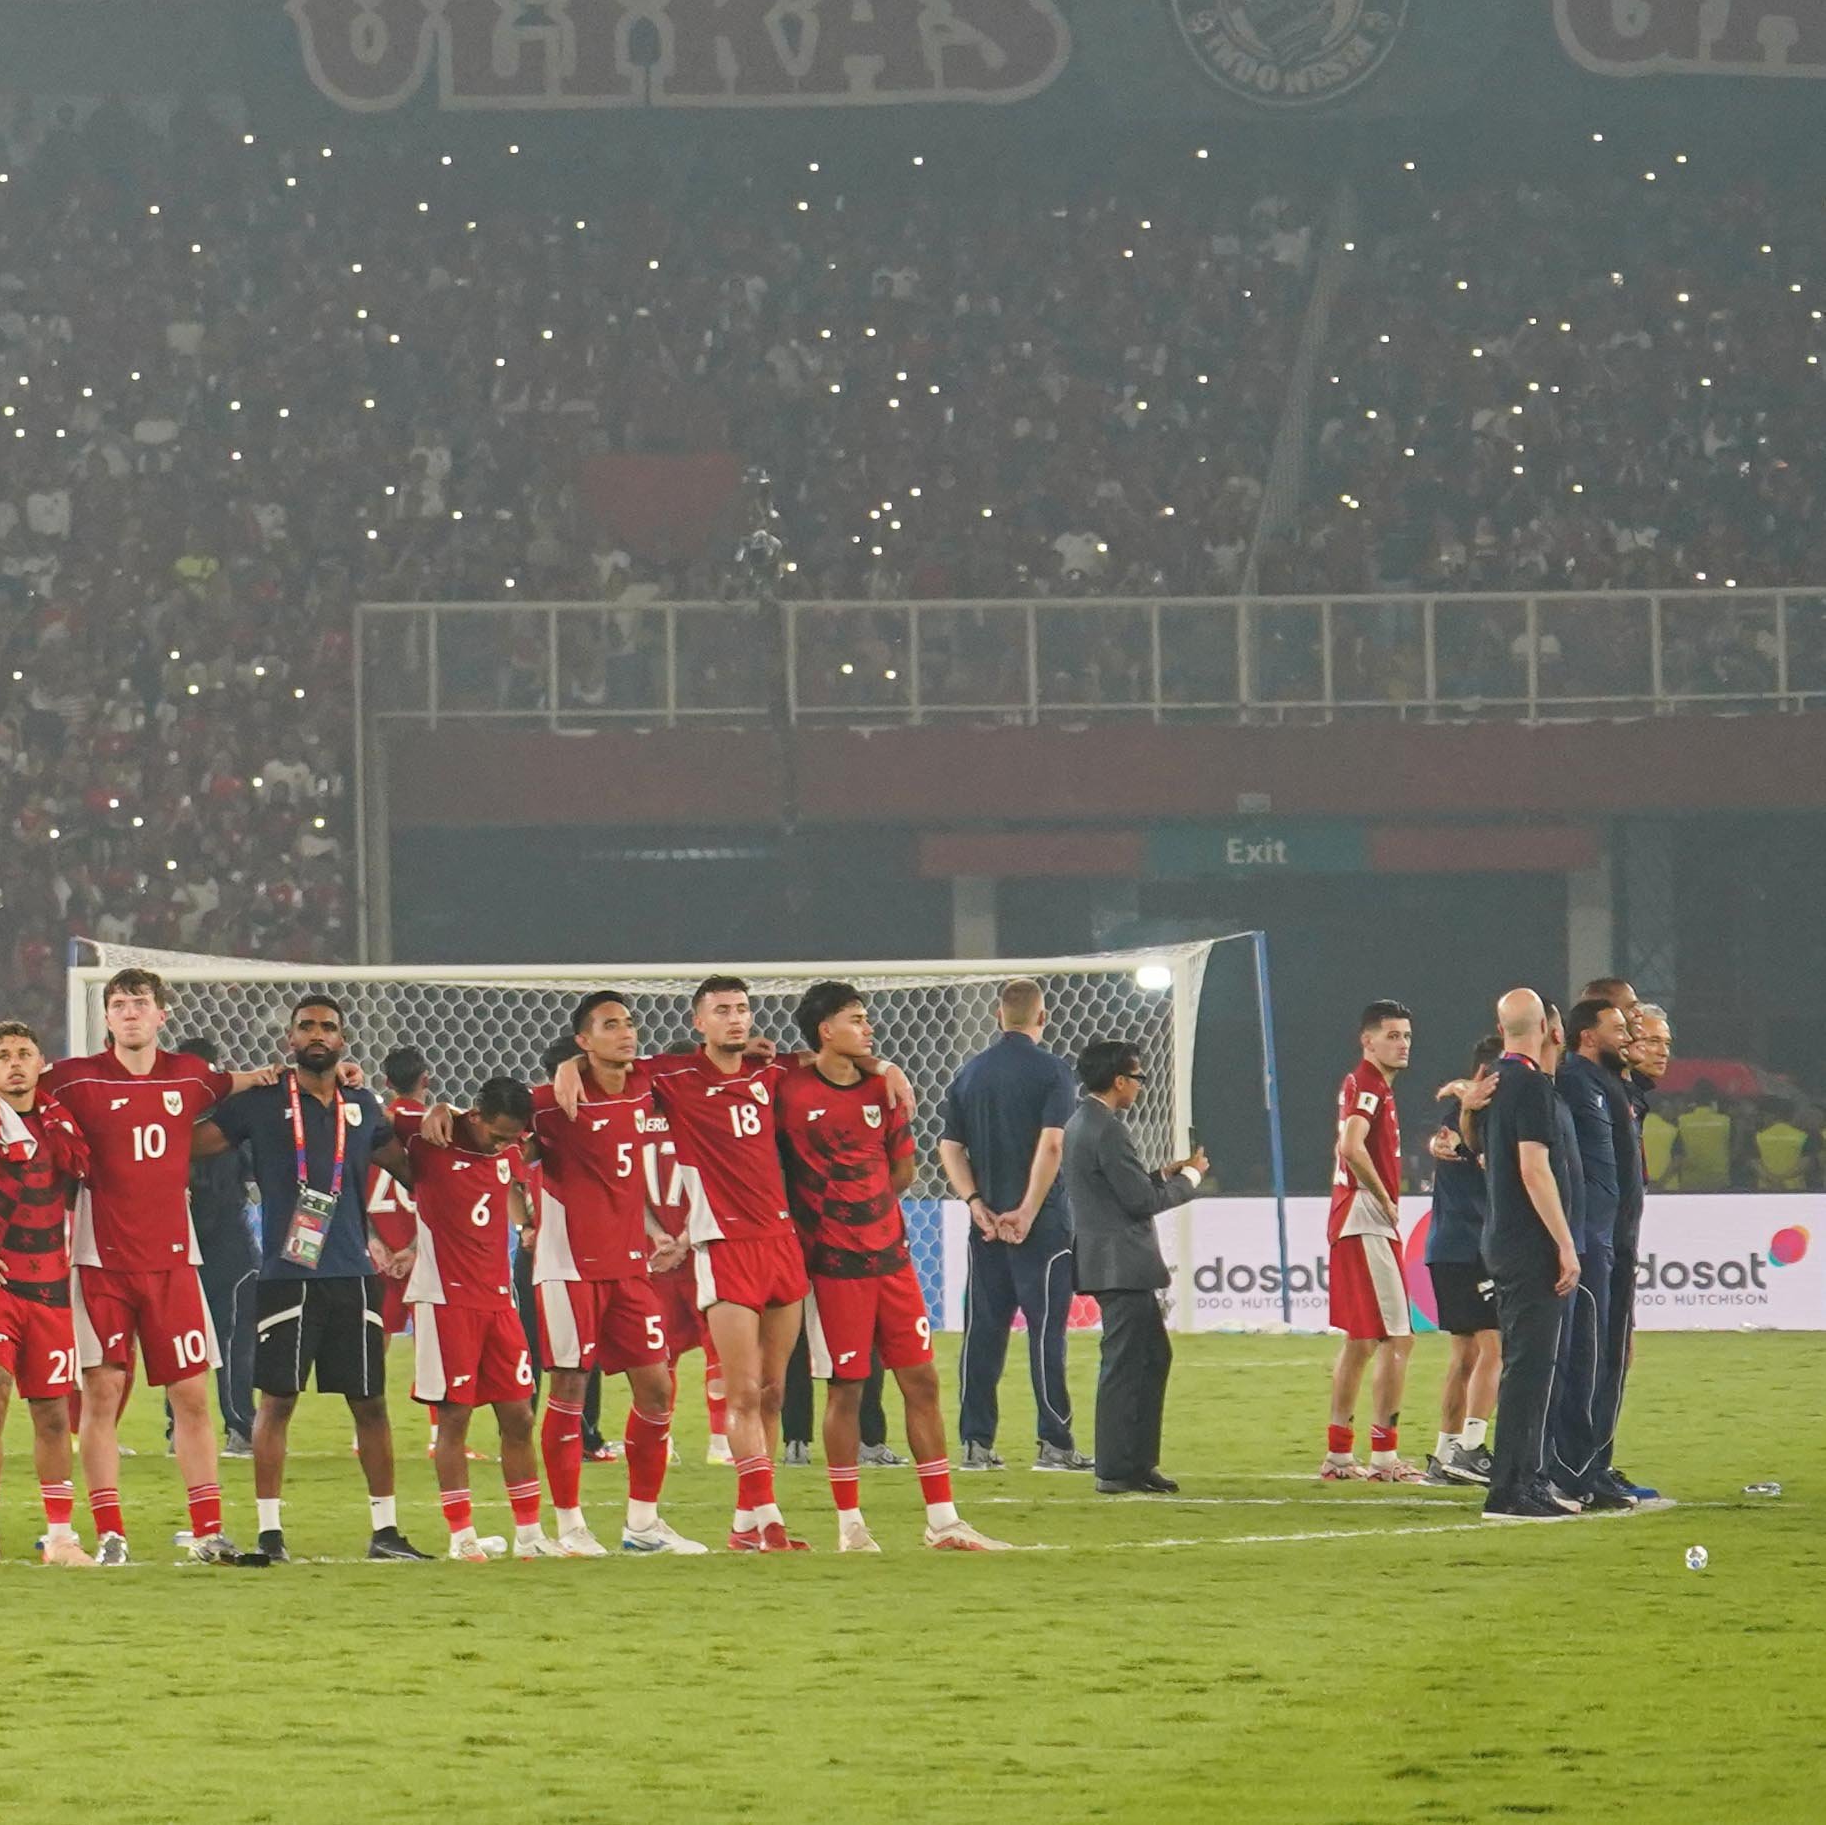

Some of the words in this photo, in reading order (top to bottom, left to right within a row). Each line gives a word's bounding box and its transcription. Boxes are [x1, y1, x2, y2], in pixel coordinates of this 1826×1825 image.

[1225, 837, 1288, 864] Exit
[730, 1104, 762, 1138] 18
[133, 1123, 167, 1162] 10
[616, 1142, 633, 1178] 5
[471, 1194, 491, 1227] 6
[1674, 1293, 1769, 1306] HUTCHISON
[172, 1331, 207, 1368] 10
[645, 1315, 665, 1351] 5
[915, 1315, 931, 1351] 9
[48, 1348, 75, 1384] 21
[515, 1349, 533, 1386] 6
